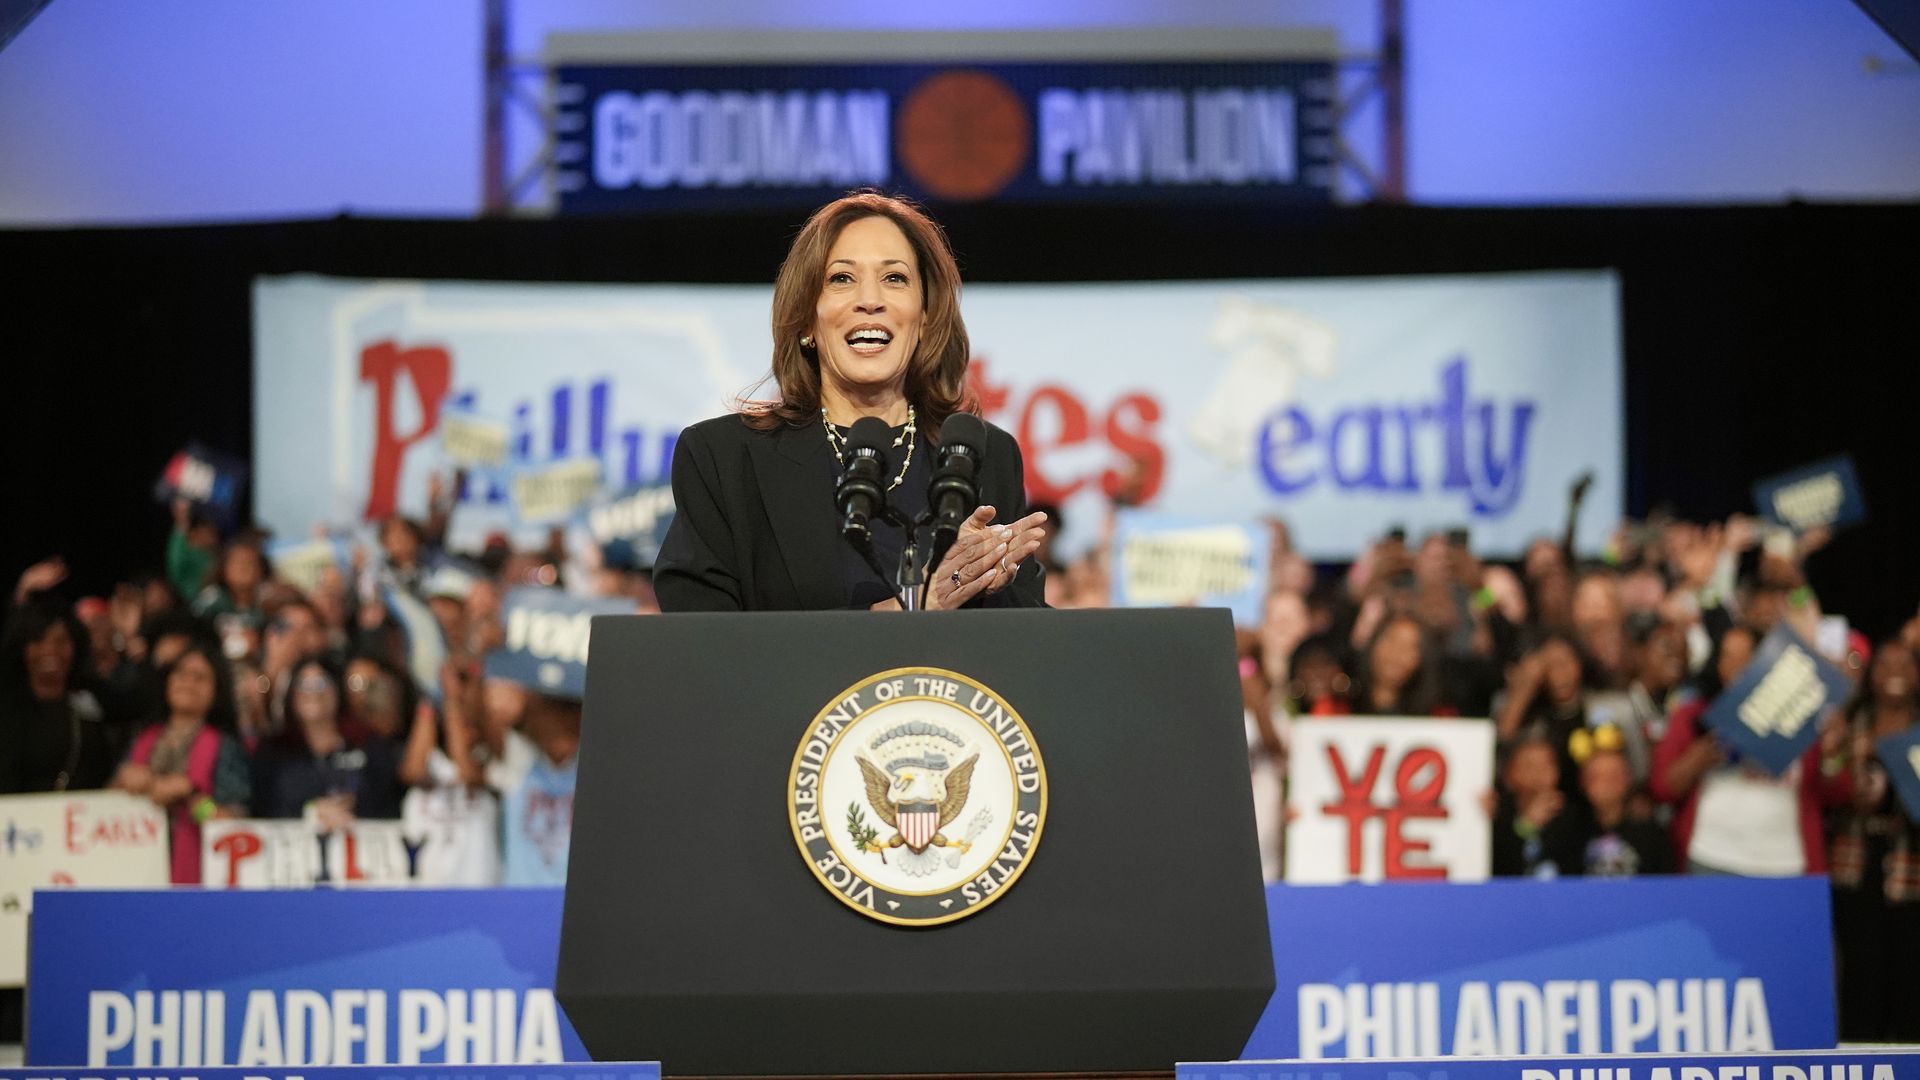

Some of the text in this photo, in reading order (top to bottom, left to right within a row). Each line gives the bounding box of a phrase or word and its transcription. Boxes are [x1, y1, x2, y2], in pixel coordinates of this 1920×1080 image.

[594, 87, 1296, 187] GOODMAN PAVILION
[1256, 356, 1534, 516] early
[875, 679, 905, 702] OF
[914, 677, 960, 702] THE
[795, 692, 866, 845] PRESIDENT
[968, 690, 1041, 794] UNITED
[816, 849, 876, 911] VICE
[961, 810, 1039, 906] STATES
[88, 988, 564, 1067] PHILADELPHIA
[1298, 978, 1774, 1060] PHILADELPHIA
